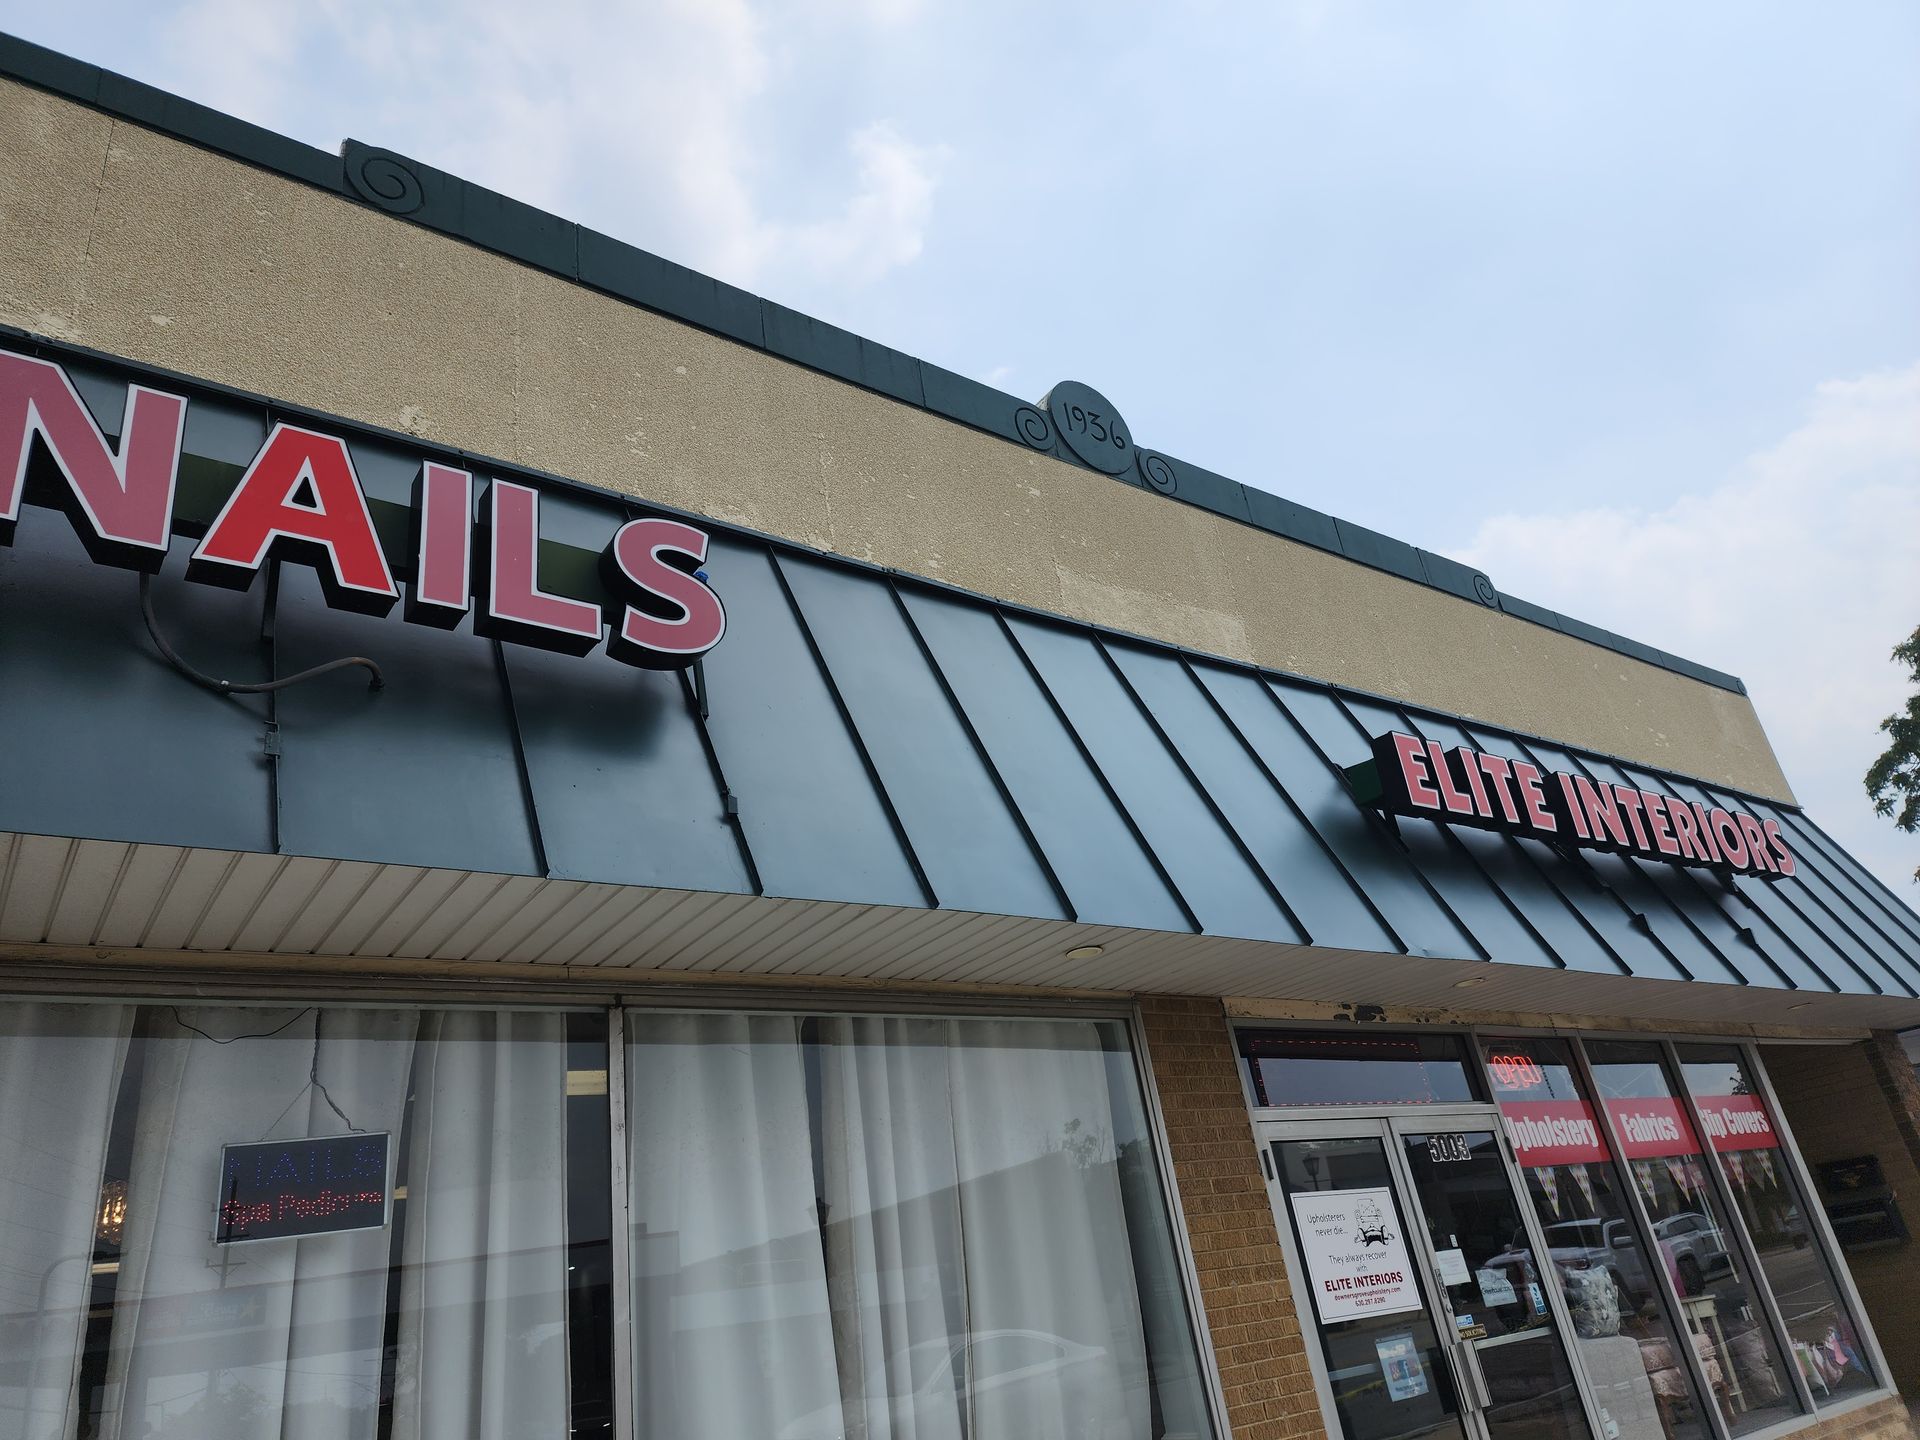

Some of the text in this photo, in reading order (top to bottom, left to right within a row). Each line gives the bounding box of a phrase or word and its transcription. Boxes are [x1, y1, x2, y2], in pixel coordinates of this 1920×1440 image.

[1063, 402, 1126, 450] 1936
[0, 347, 728, 656] NAILS
[1391, 731, 1797, 877] ELITE INTERIORS
[1493, 1055, 1542, 1085] OPEN
[1504, 1115, 1599, 1152] Upholstery
[1619, 1112, 1680, 1142] Fabrics
[1721, 1107, 1770, 1135] Covers
[222, 1199, 271, 1231] Spa
[1306, 1213, 1346, 1226] Upholsterers
[1315, 1228, 1332, 1237] never
[1328, 1250, 1387, 1266] They always recover
[1356, 1264, 1368, 1272] with
[1324, 1271, 1404, 1292] ELITE INTERIORS
